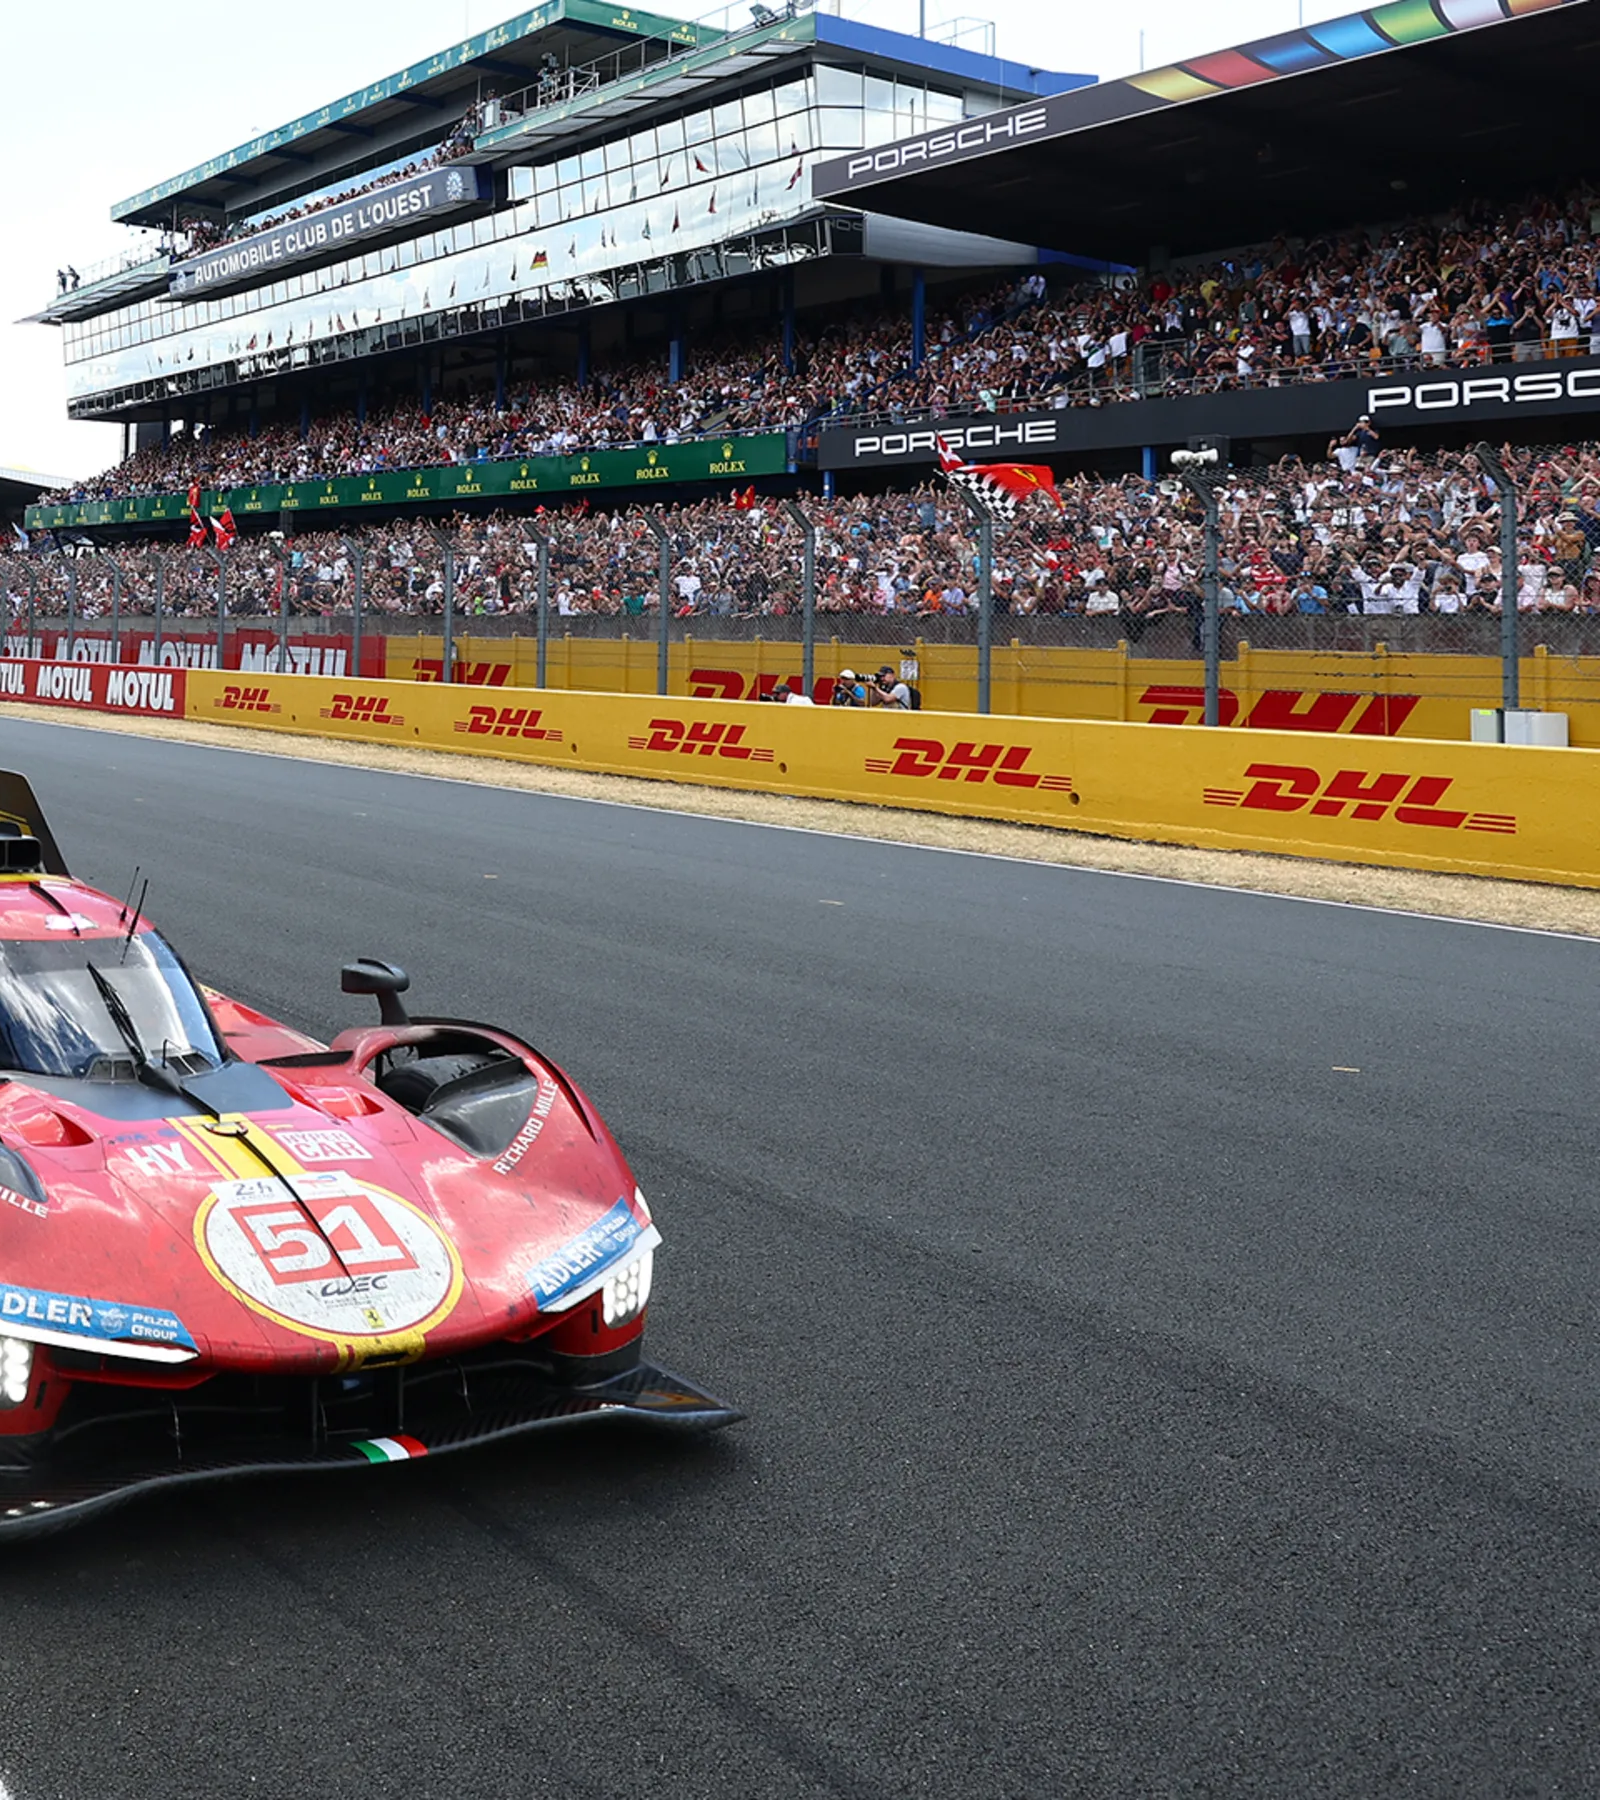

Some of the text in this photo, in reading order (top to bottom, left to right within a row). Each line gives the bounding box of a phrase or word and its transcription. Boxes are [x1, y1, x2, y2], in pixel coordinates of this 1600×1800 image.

[612, 17, 638, 30] ROLEX
[848, 108, 1046, 179] PORSCHE
[194, 185, 433, 285] AUTOMOBILE CLUB DE L'OUEST
[855, 420, 1056, 457] PORSCHE
[570, 472, 600, 484] ROLEX
[636, 466, 669, 479] ROLEX
[709, 460, 746, 474] ROLEX
[361, 490, 382, 501] ROLEX
[406, 486, 430, 498] ROLEX
[456, 482, 482, 494] ROLEX
[510, 478, 538, 490] ROLEX
[36, 665, 92, 702] MOTUL
[106, 670, 175, 711] MOTUL
[222, 686, 272, 712] DHL
[330, 694, 393, 724] DHL
[468, 706, 547, 739] DHL
[646, 718, 754, 760] DHL
[890, 738, 1042, 788] DHL
[1240, 763, 1469, 829] DHL
[492, 1078, 560, 1176] RICHARD MILLE
[124, 1142, 192, 1176] HY
[294, 1142, 366, 1158] CAR
[244, 1204, 406, 1274] 51
[539, 1238, 604, 1296] ADLER
[321, 1274, 388, 1297] WEC
[130, 1324, 178, 1340] GROUP
[132, 1312, 178, 1329] PELZER
